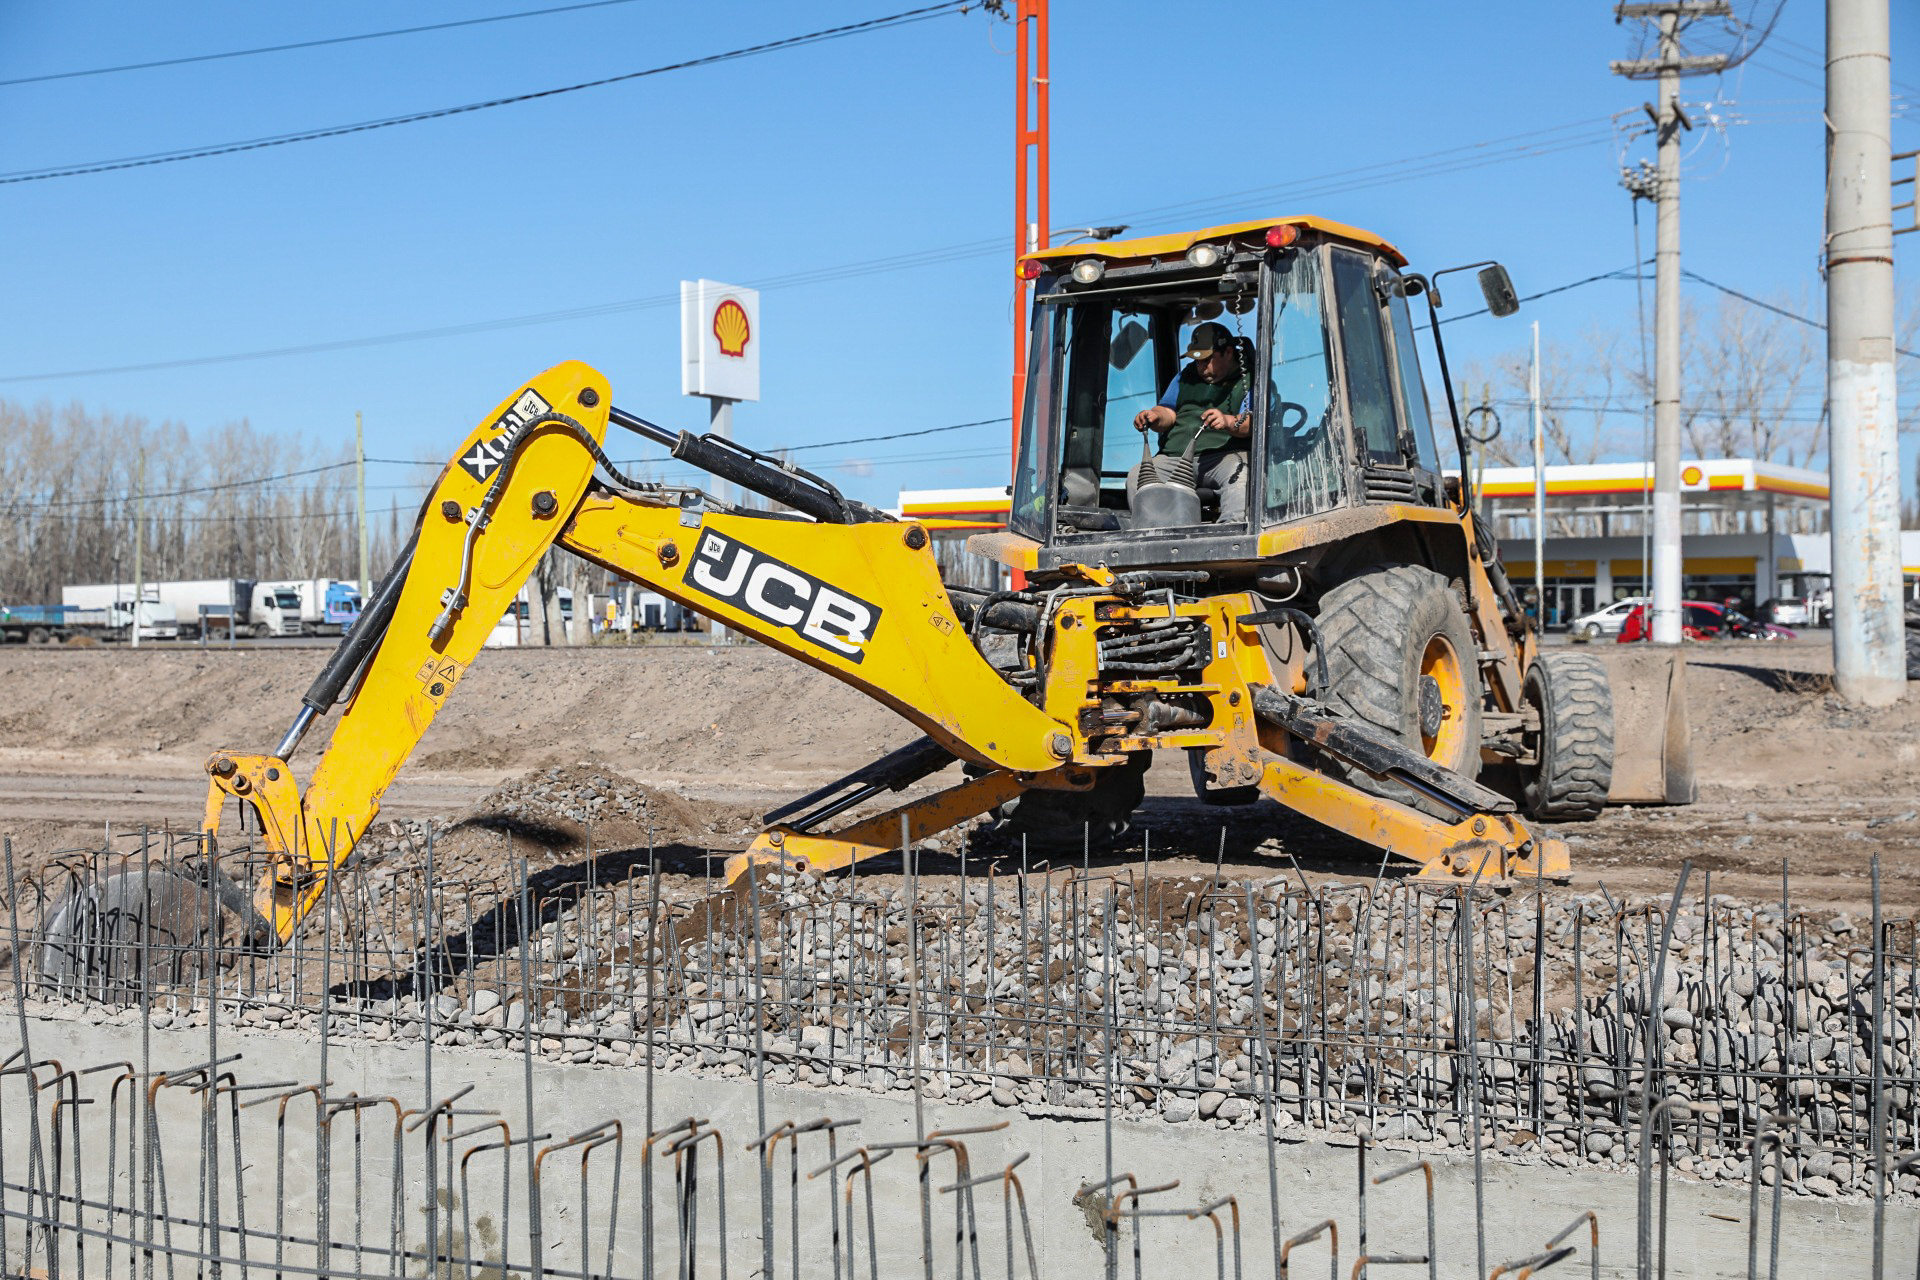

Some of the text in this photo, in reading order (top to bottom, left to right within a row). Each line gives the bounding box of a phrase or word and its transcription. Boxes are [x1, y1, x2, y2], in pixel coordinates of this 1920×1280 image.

[524, 400, 540, 416] JCB
[708, 540, 721, 553] JCB
[693, 548, 871, 654] JCB
